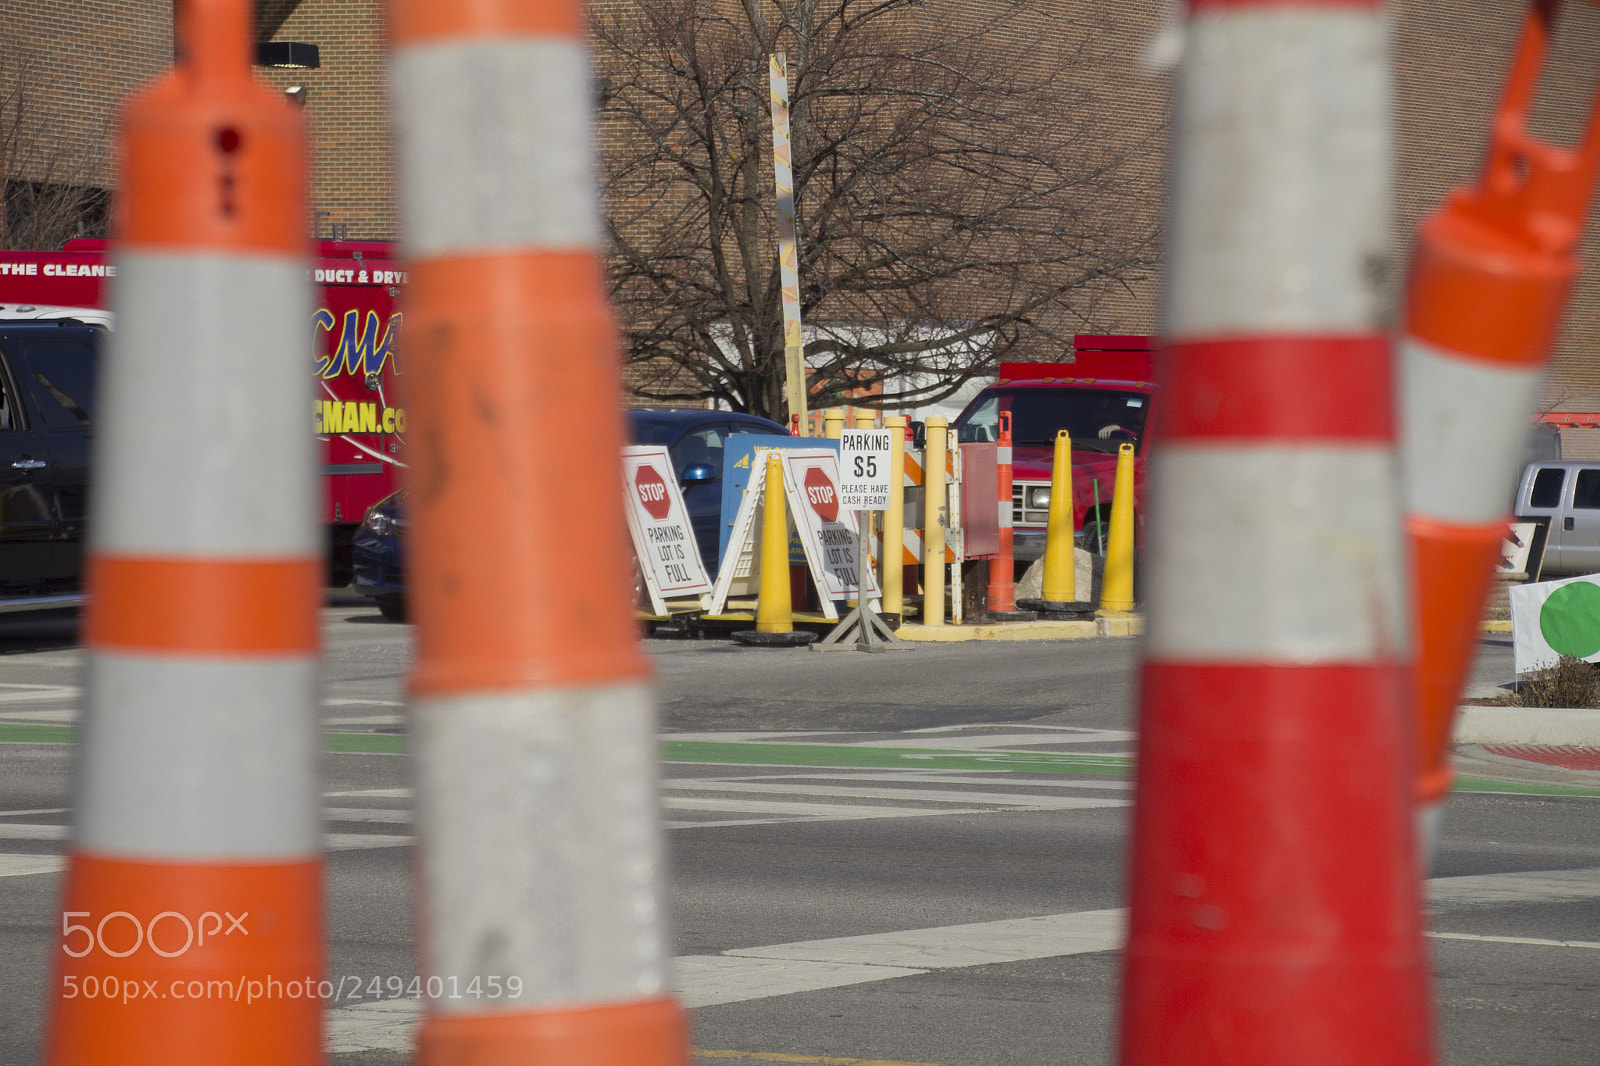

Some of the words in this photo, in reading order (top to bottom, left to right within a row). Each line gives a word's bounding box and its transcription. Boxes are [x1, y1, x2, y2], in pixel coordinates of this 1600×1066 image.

[315, 270, 355, 283] DUCT
[358, 271, 369, 283] &
[842, 434, 889, 451] PARKING
[853, 454, 877, 479] $5
[638, 483, 665, 502] STOP
[807, 486, 834, 505] STOP
[841, 484, 868, 494] PLEASE
[870, 484, 888, 494] HAVE
[842, 495, 861, 505] CASH
[863, 495, 887, 505] READY
[648, 525, 684, 543] PARKING
[817, 529, 852, 546] PARKING
[657, 545, 672, 561] LOT
[673, 544, 685, 560] IS
[826, 549, 842, 564] LOT
[843, 548, 853, 564] IS
[664, 563, 692, 583] FULL
[834, 569, 859, 586] FULL
